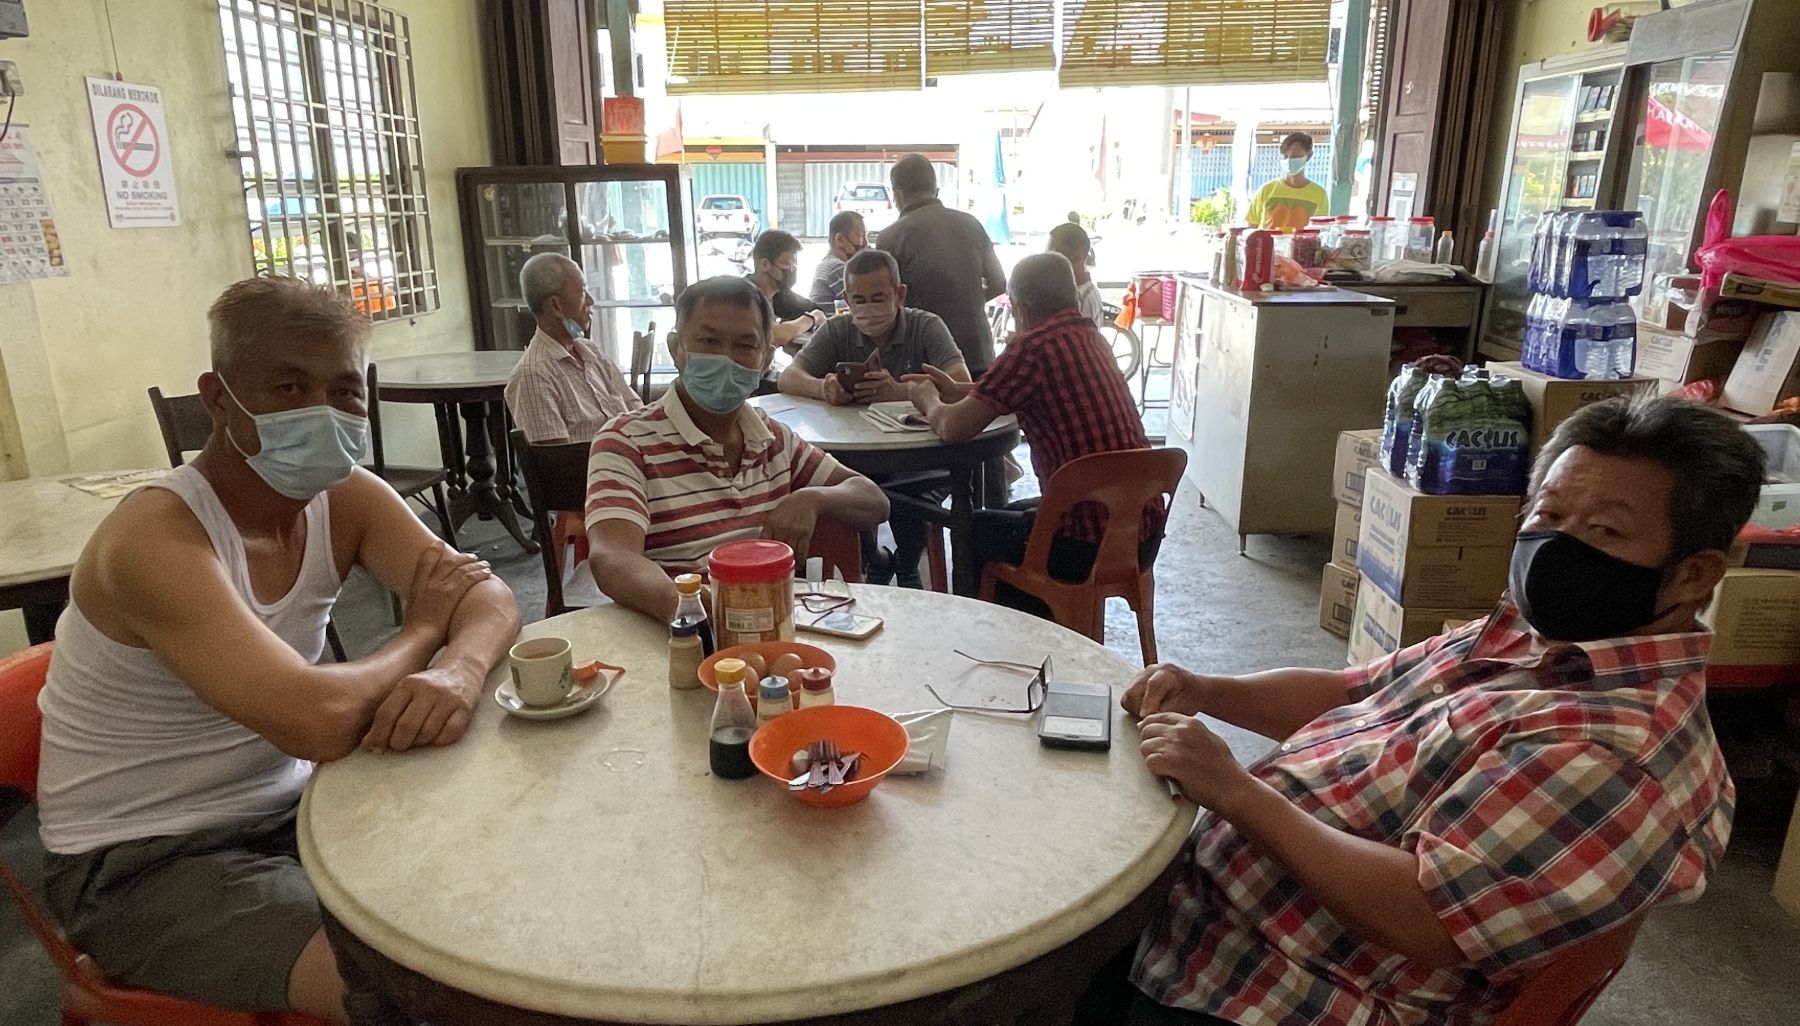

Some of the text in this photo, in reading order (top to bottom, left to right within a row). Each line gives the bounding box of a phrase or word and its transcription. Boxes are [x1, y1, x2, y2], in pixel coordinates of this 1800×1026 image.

[91, 83, 160, 104] DILARANG MEROKOK
[115, 191, 168, 200] NO SMOKING
[1446, 428, 1519, 450] CACTUS
[1446, 506, 1488, 516] CACUS
